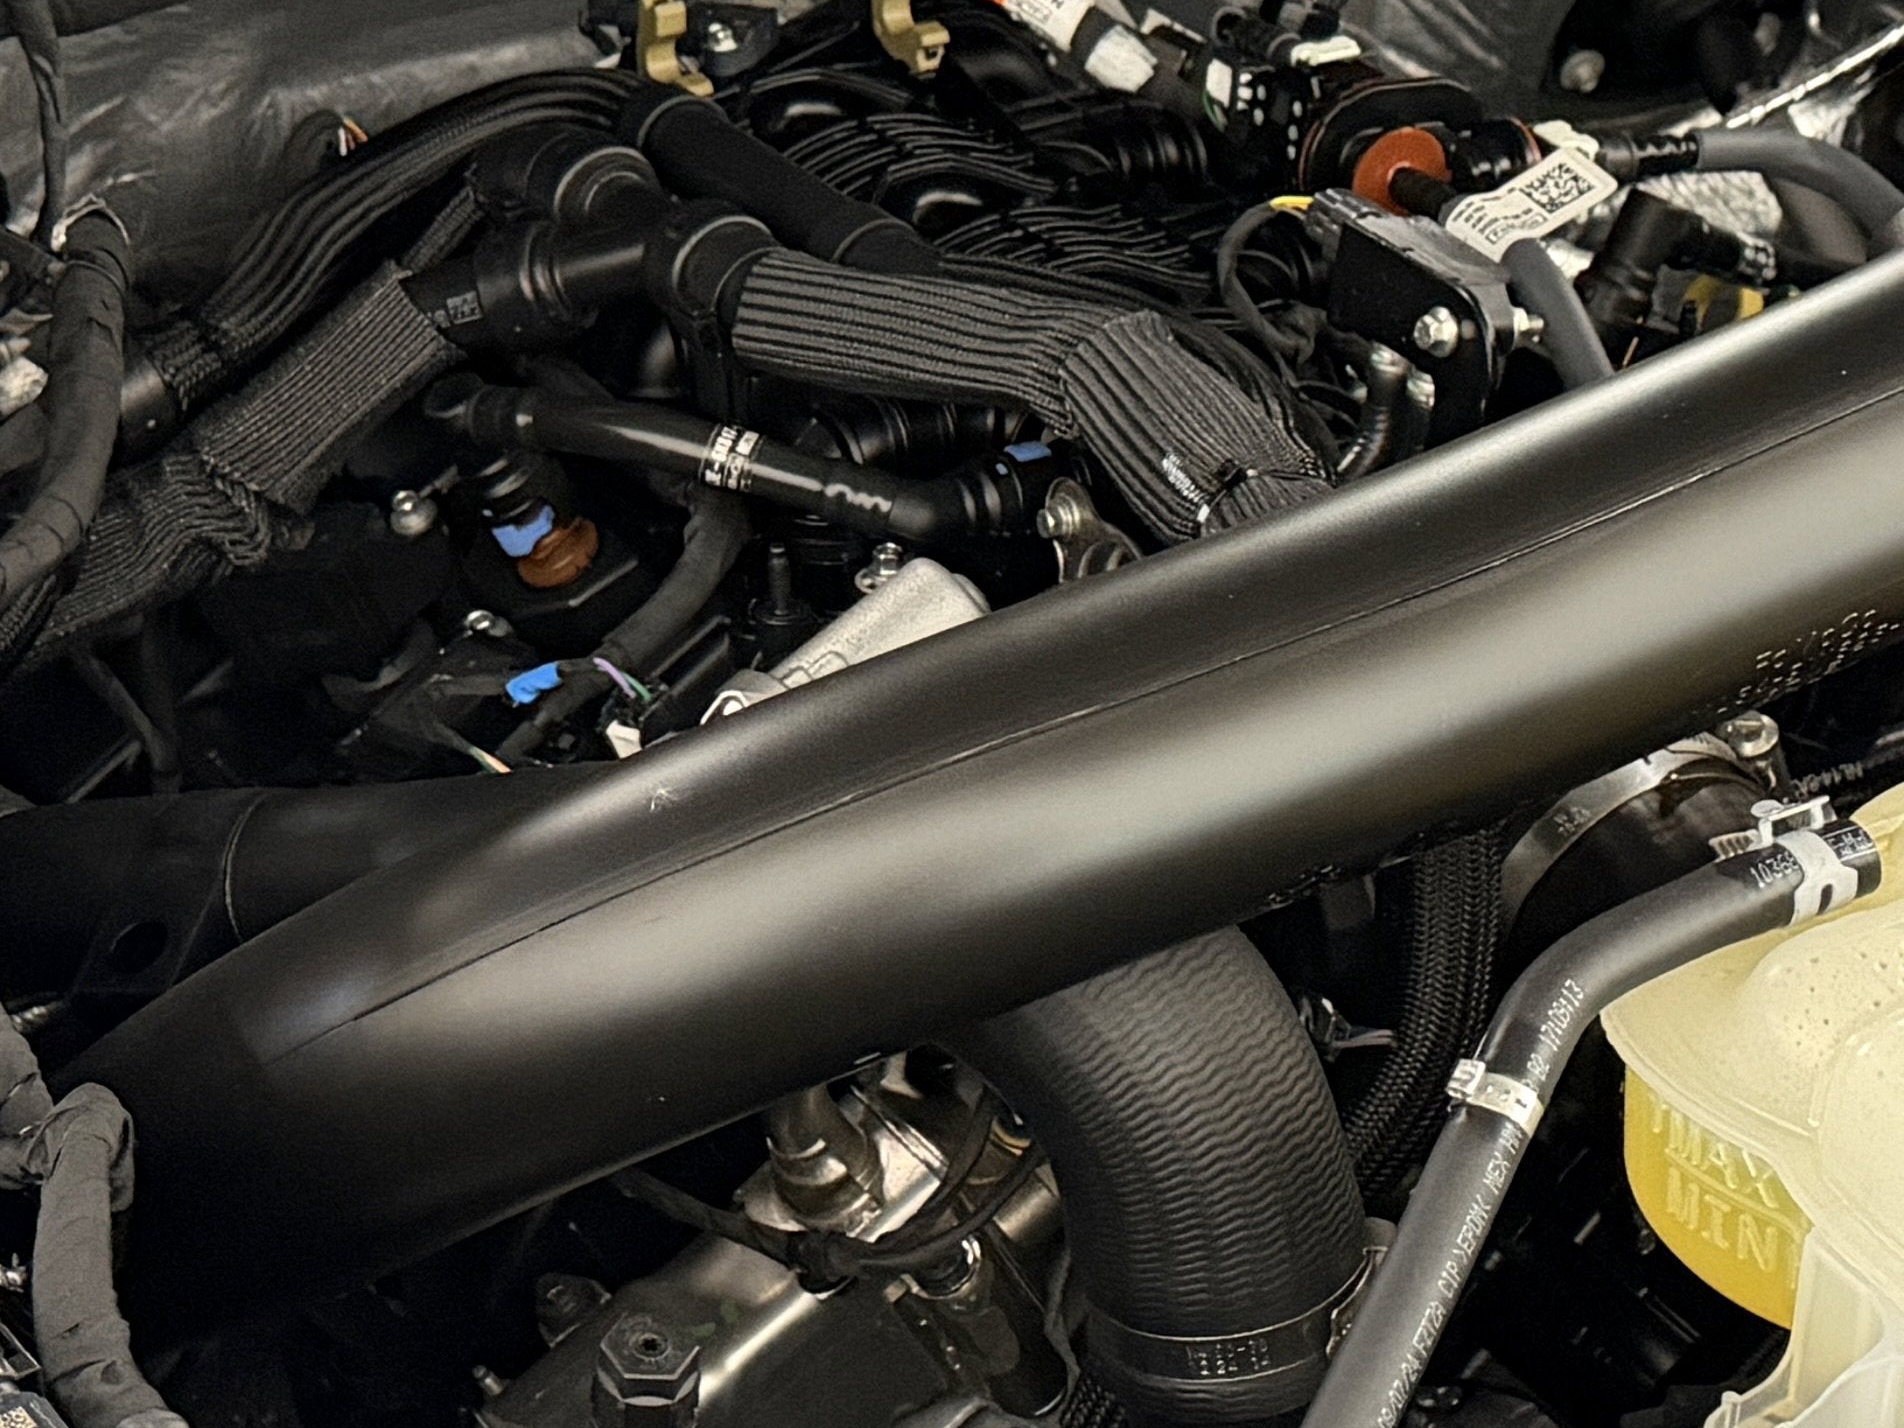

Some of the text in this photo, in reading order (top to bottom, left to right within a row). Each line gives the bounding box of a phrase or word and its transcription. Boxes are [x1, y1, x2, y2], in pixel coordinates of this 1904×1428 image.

[1481, 1151, 1509, 1193] MEX
[1667, 1108, 1778, 1209] MAX
[1667, 1166, 1778, 1273] MIN
